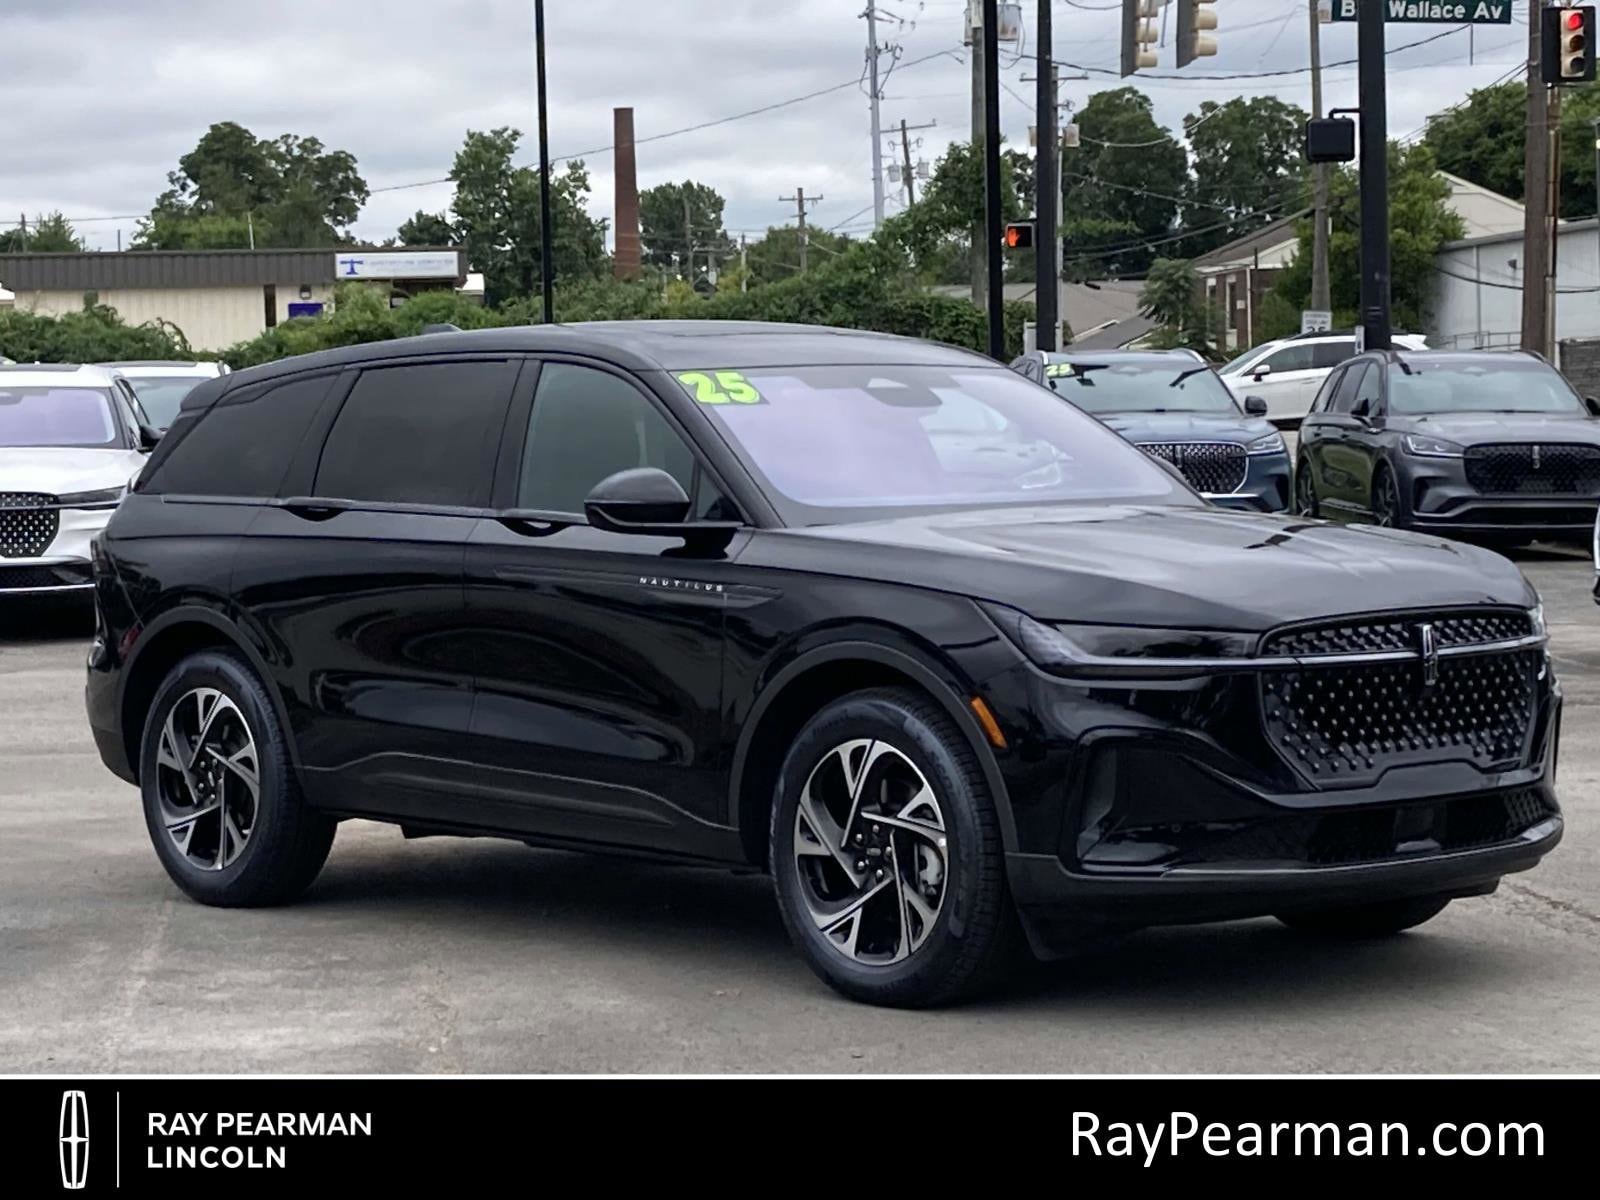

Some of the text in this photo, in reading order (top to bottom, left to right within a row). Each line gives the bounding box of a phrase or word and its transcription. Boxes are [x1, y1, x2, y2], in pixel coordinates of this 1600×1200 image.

[1388, 0, 1503, 20] Wallace Av
[678, 371, 760, 405] 25
[639, 576, 724, 592] NAUTILUS
